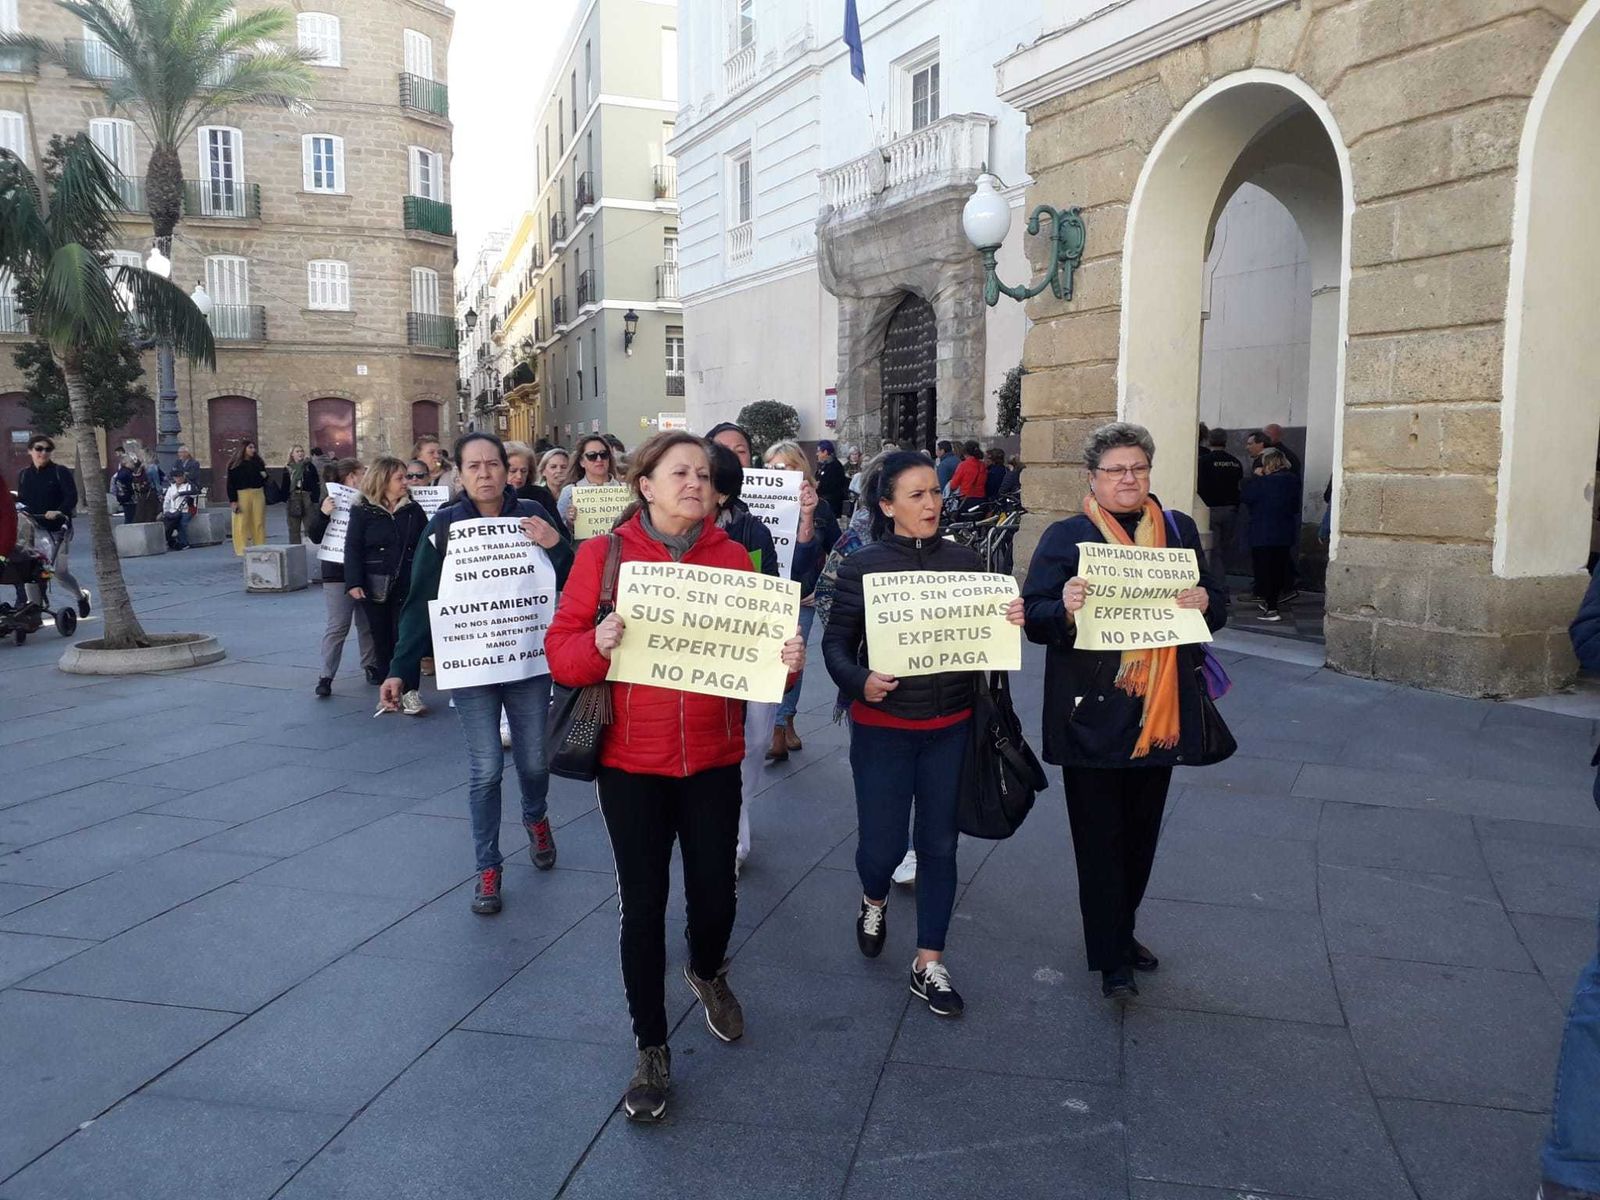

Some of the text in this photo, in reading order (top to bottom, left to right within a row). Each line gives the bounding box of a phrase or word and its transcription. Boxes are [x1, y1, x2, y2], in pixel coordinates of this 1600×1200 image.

[579, 506, 597, 514] SUS
[463, 545, 480, 553] LAS
[482, 541, 540, 551] TRABAJADOR
[1085, 546, 1191, 563] LIMPIADORAS DEL
[455, 551, 528, 566] DESAMPARADAS
[454, 564, 535, 582] SIN COBRAR
[631, 565, 794, 596] LIMPIADORAS DEL
[872, 574, 1009, 587] LIMPIADORAS DEL
[1085, 564, 1196, 580] AYTO. SIN COBRAR
[872, 586, 1015, 605] AYTO. SIN COBRAR
[1087, 584, 1117, 597] SUS
[439, 595, 549, 617] AYUNTAMIENTO
[627, 583, 794, 616] AYTO. SIN COBRAR
[490, 613, 539, 625] ABANDONES
[878, 602, 1010, 624] SUS NOMINAS
[1094, 606, 1174, 621] EXPERTUS
[630, 604, 785, 640] SUS NOMINAS
[443, 633, 475, 642] TENEIS
[490, 628, 524, 638] SARTEN
[525, 624, 539, 633] POR
[898, 626, 992, 646] EXPERTUS
[1101, 629, 1180, 644] NO PAGA
[485, 640, 517, 649] MANGO
[647, 633, 759, 664] EXPERTUS
[442, 654, 505, 670] OBLIGALE
[508, 653, 516, 662] A
[908, 651, 989, 670] NO PAGA
[651, 663, 749, 692] NO PAGA
